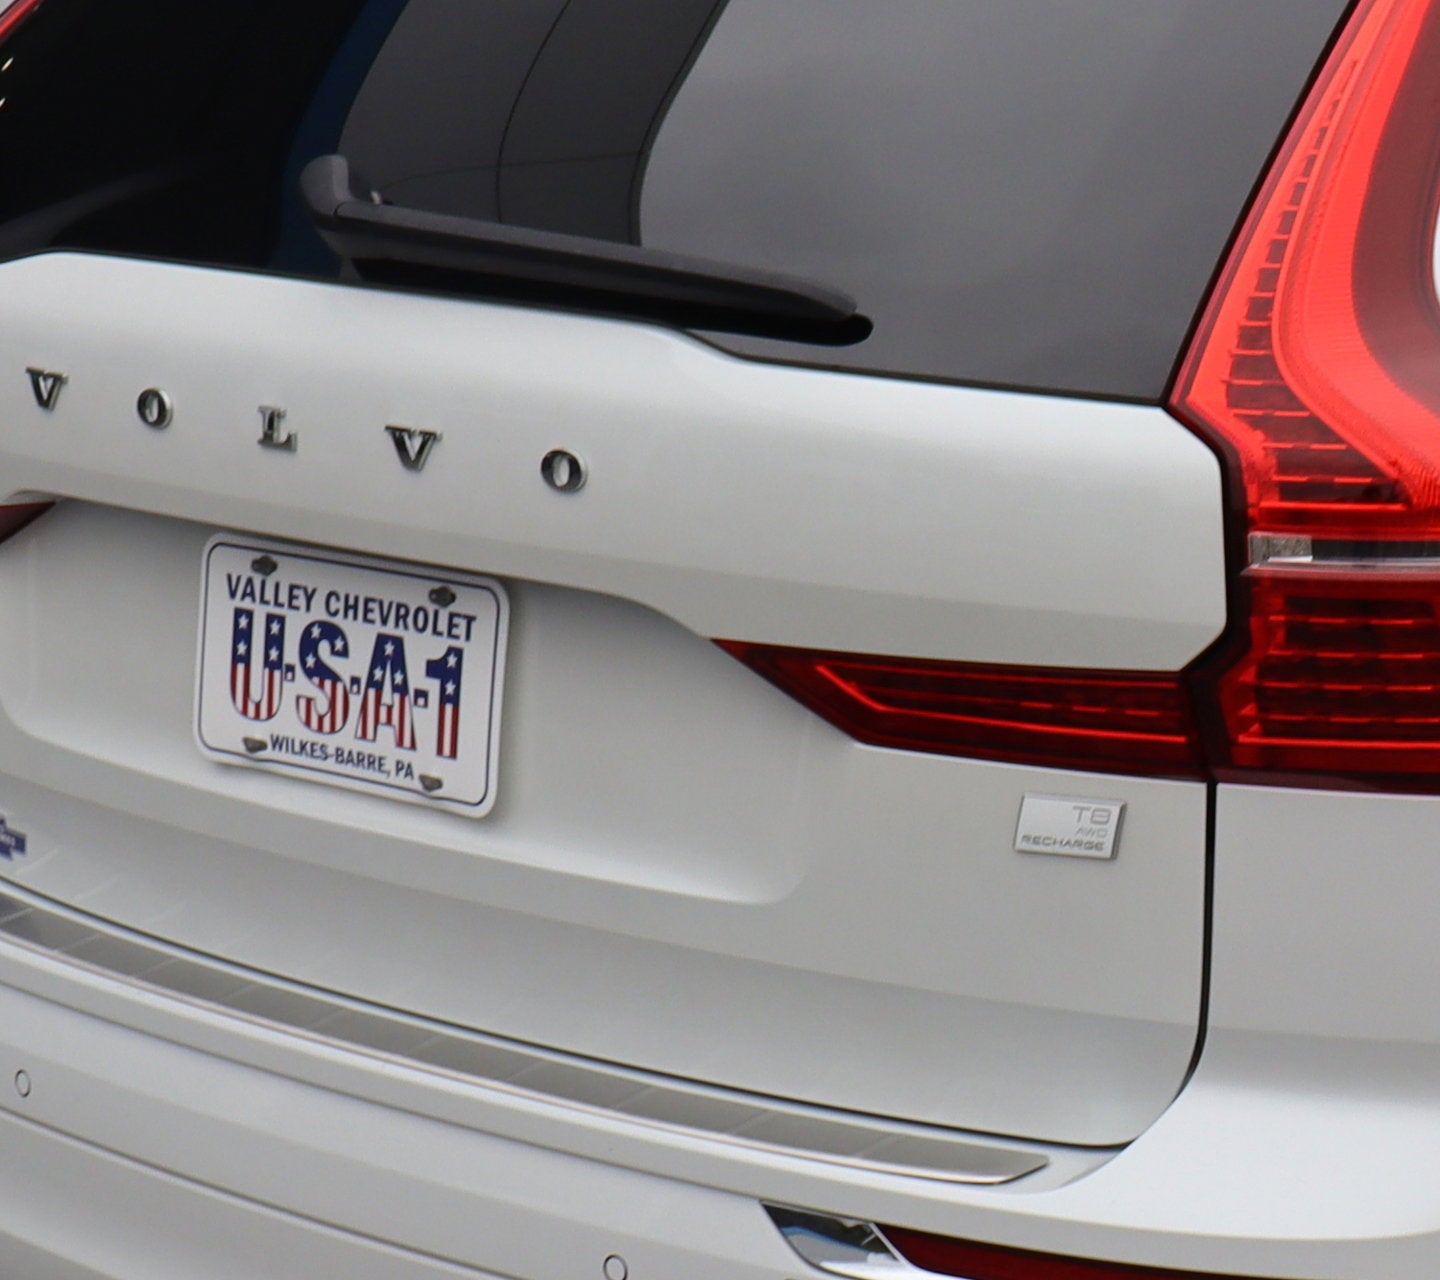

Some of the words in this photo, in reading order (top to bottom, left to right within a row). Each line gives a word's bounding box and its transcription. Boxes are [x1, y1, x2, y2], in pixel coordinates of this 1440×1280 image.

[25, 366, 588, 493] VOLVO
[226, 572, 317, 614] VALLEY
[324, 589, 478, 643] CHEVROLET
[269, 733, 391, 778] WILKES-BARRE,
[394, 759, 415, 781] PA
[1073, 806, 1112, 825] T8
[1022, 835, 1105, 852] RECHARGE
[1076, 827, 1108, 838] AWD
